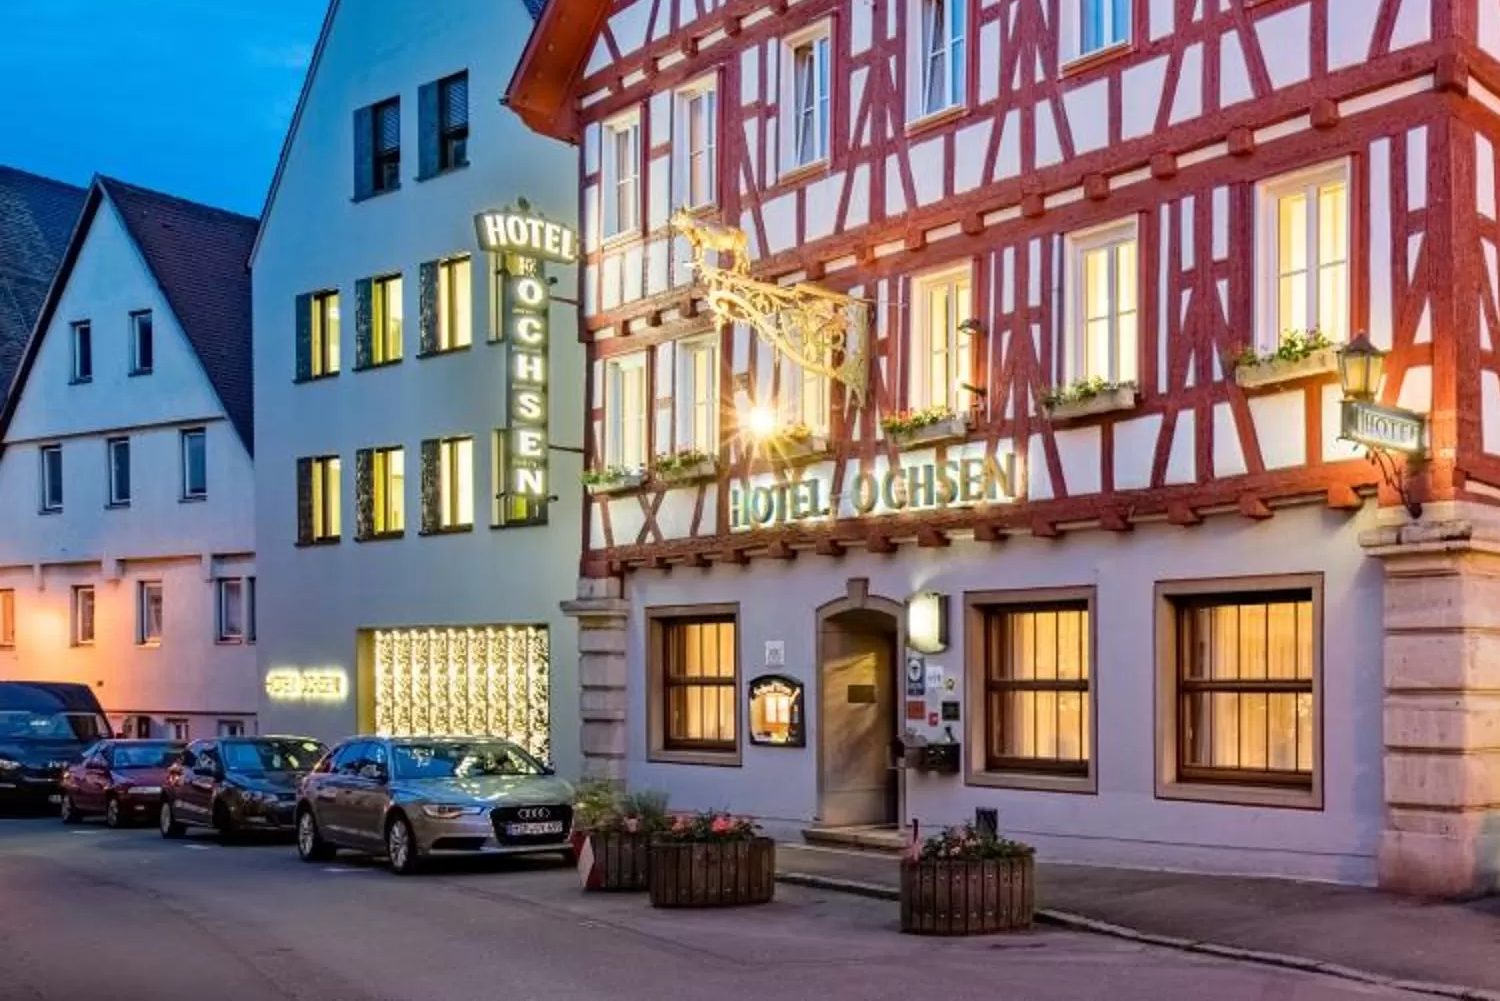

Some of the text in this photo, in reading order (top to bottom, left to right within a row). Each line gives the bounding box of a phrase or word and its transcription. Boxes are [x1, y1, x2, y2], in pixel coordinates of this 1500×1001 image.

[484, 215, 574, 260] HOTEL
[517, 279, 543, 495] OCHSEN
[731, 452, 1017, 528] HOTEL OCHSEN
